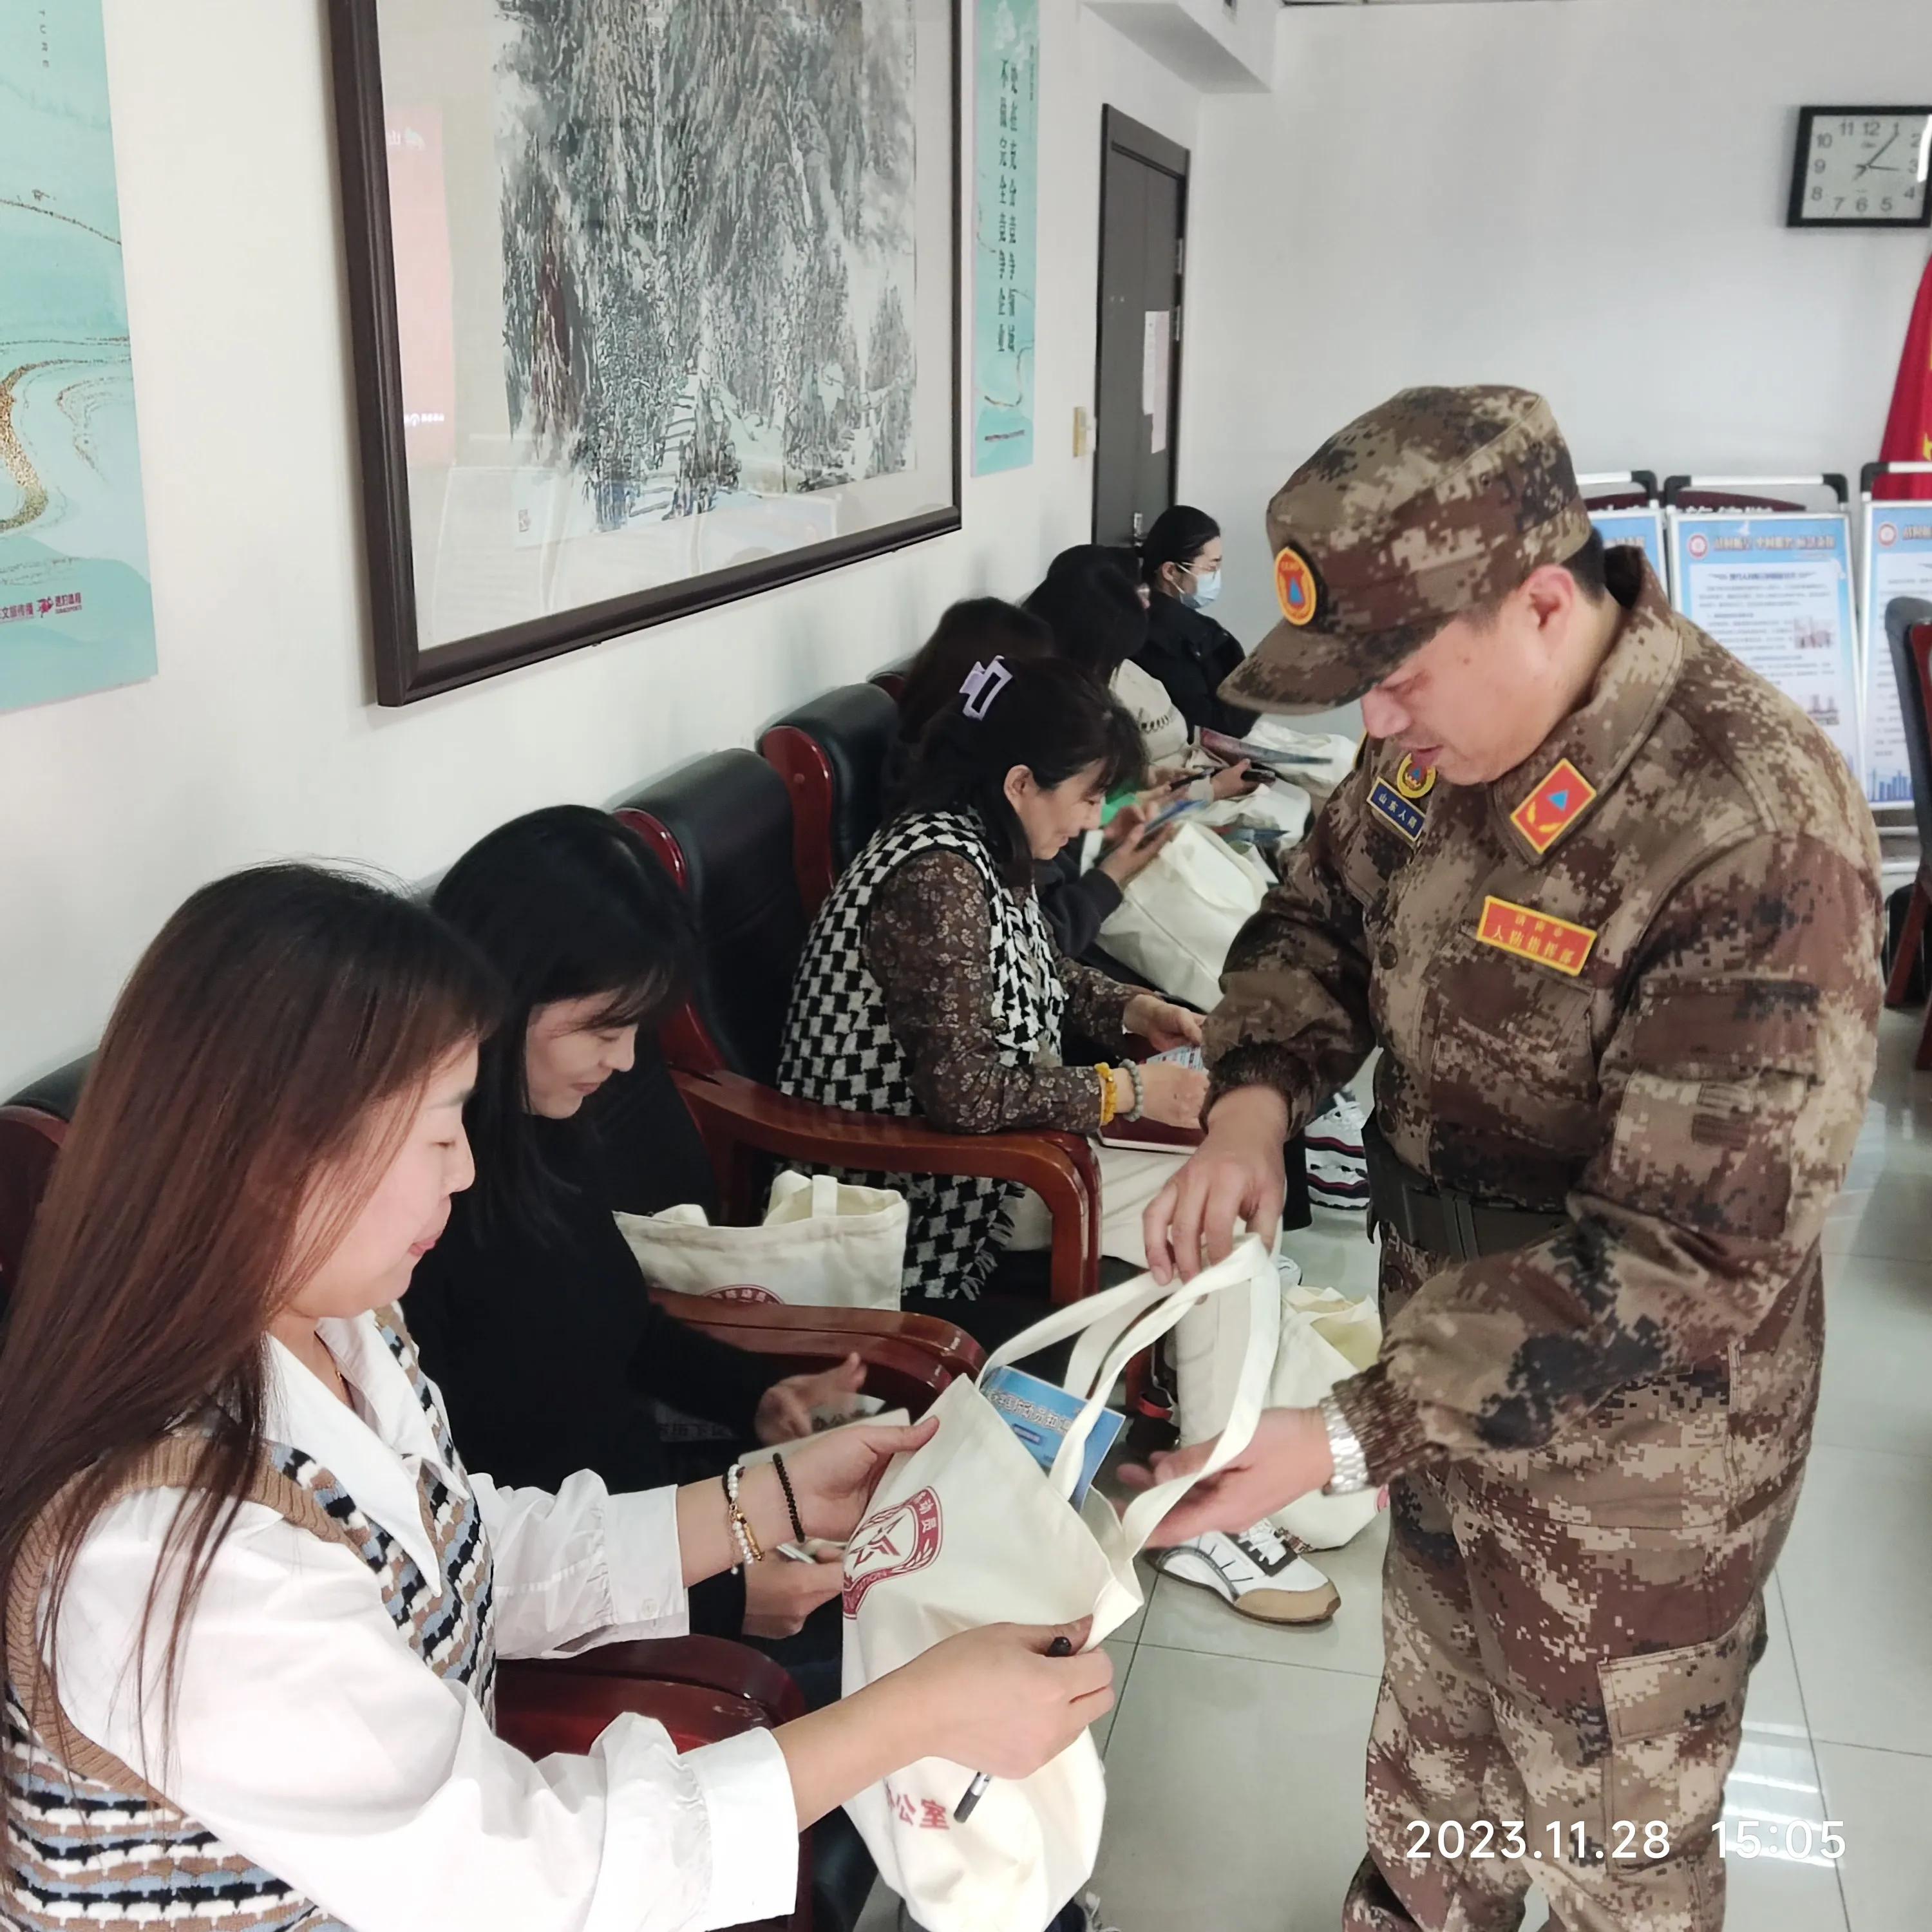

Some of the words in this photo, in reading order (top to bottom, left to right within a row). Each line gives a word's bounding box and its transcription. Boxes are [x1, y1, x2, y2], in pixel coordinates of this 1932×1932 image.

[1840, 121, 1854, 136] 11
[1864, 121, 1880, 136] 12
[1817, 133, 1833, 148] 10
[1910, 133, 1921, 147] 2
[1814, 158, 1826, 174] 9
[1908, 158, 1918, 174] 3
[1812, 186, 1823, 201] 8
[1904, 186, 1915, 200] 4
[1834, 196, 1844, 211] 7
[1855, 196, 1868, 212] 6
[1880, 196, 1892, 212] 5
